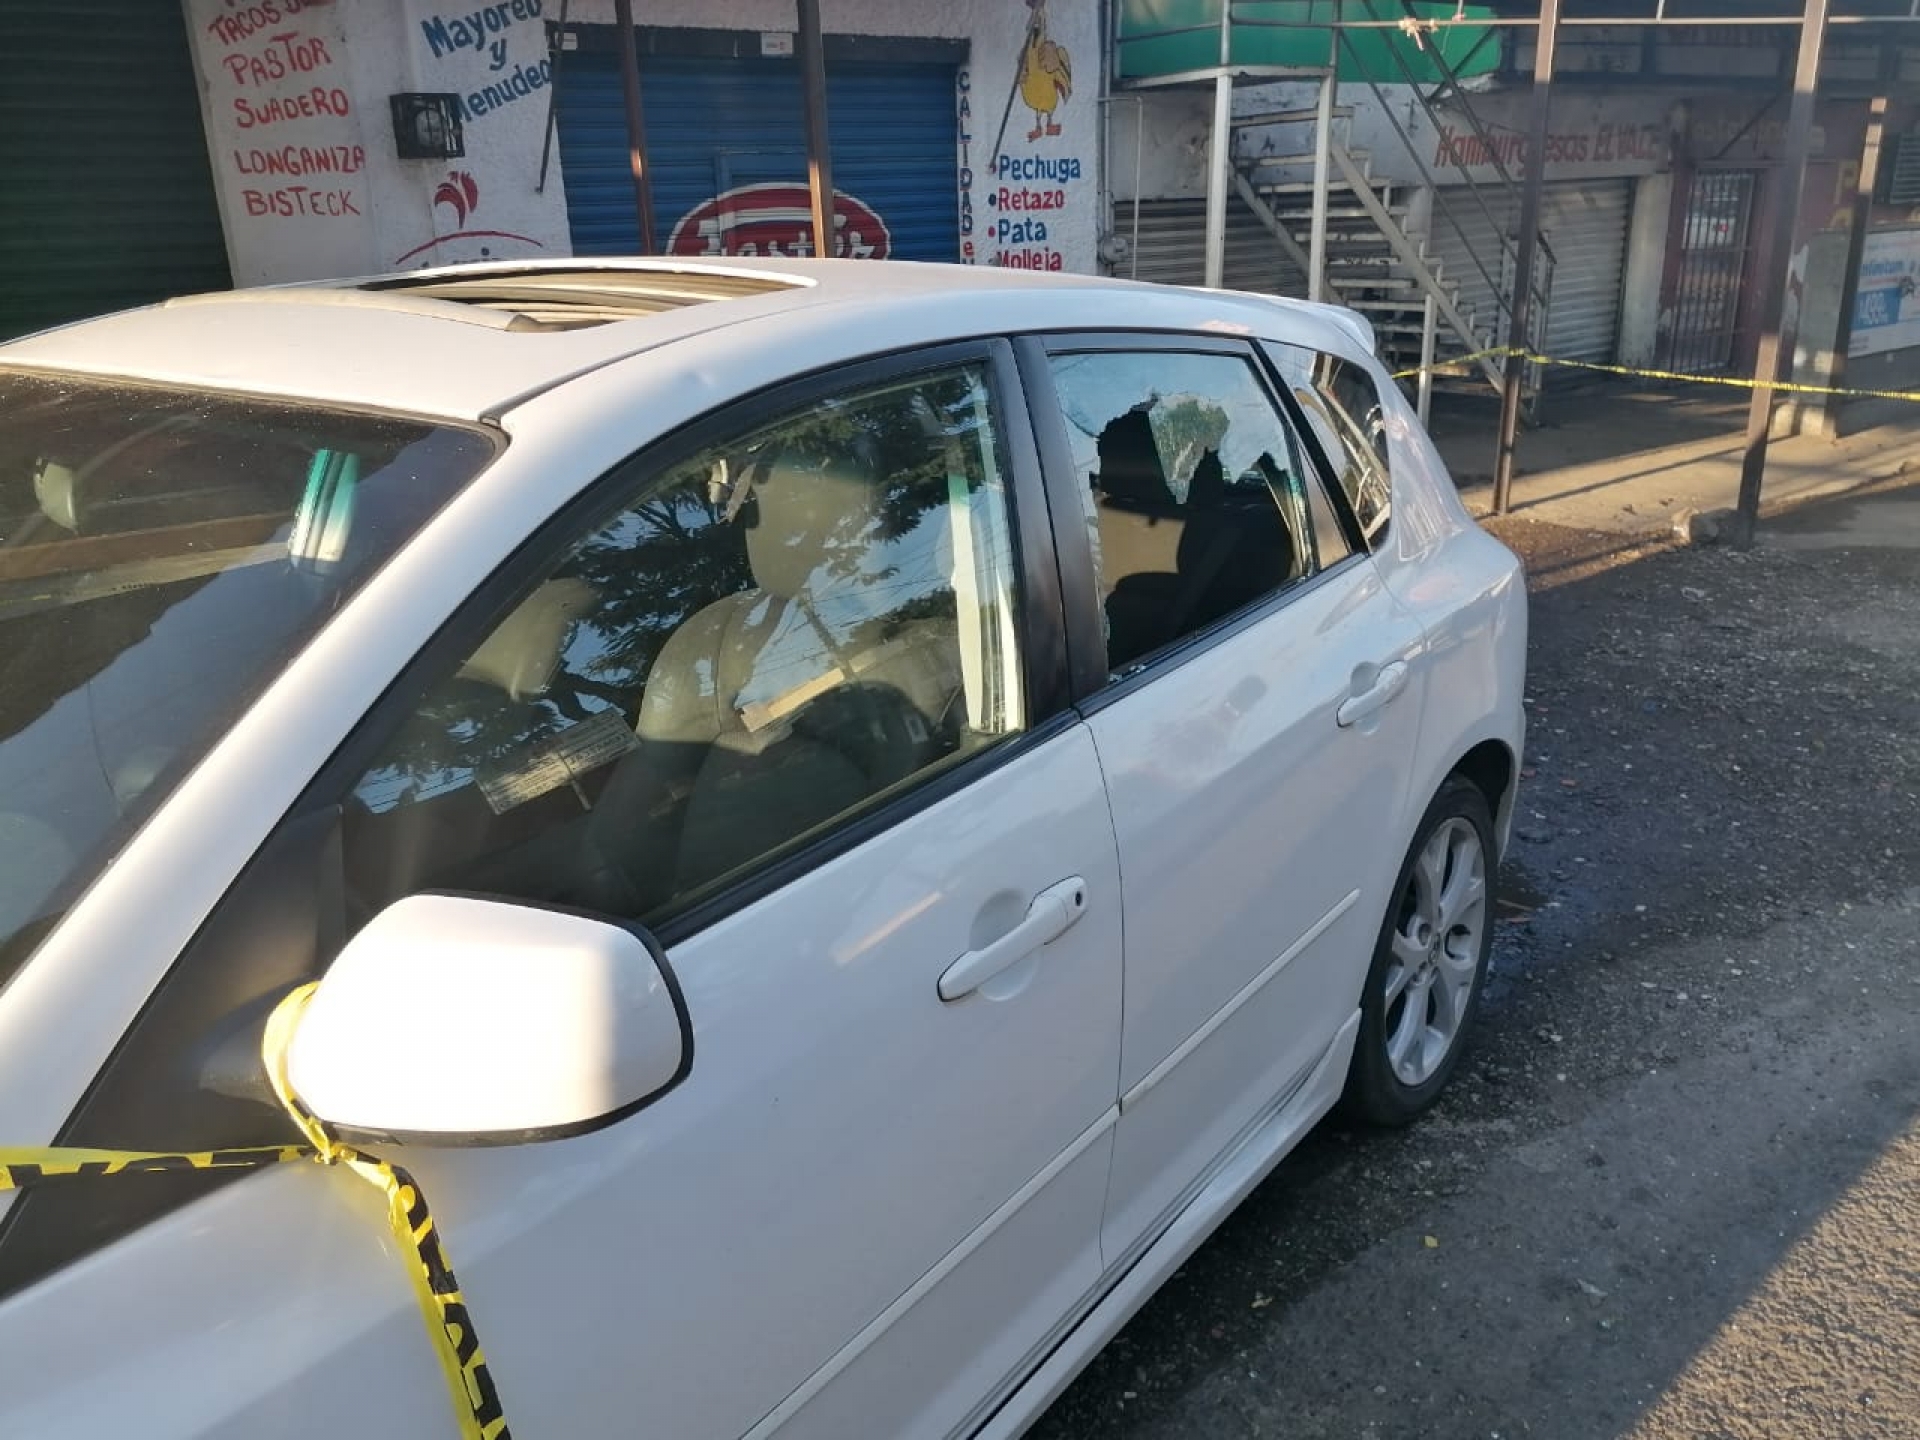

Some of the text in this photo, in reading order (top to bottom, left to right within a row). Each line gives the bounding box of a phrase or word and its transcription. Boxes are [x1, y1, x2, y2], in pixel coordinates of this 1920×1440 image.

[208, 1, 281, 45] TACOS
[420, 0, 542, 58] Mayoreo
[223, 32, 332, 87] PASTOR
[489, 38, 507, 71] y
[234, 145, 365, 175] LONGANIZA
[959, 71, 973, 236] CALIDAD
[999, 154, 1081, 184] Pechuga
[242, 186, 360, 216] BISTECK
[999, 186, 1065, 211] Retazo
[998, 216, 1047, 244] Pata
